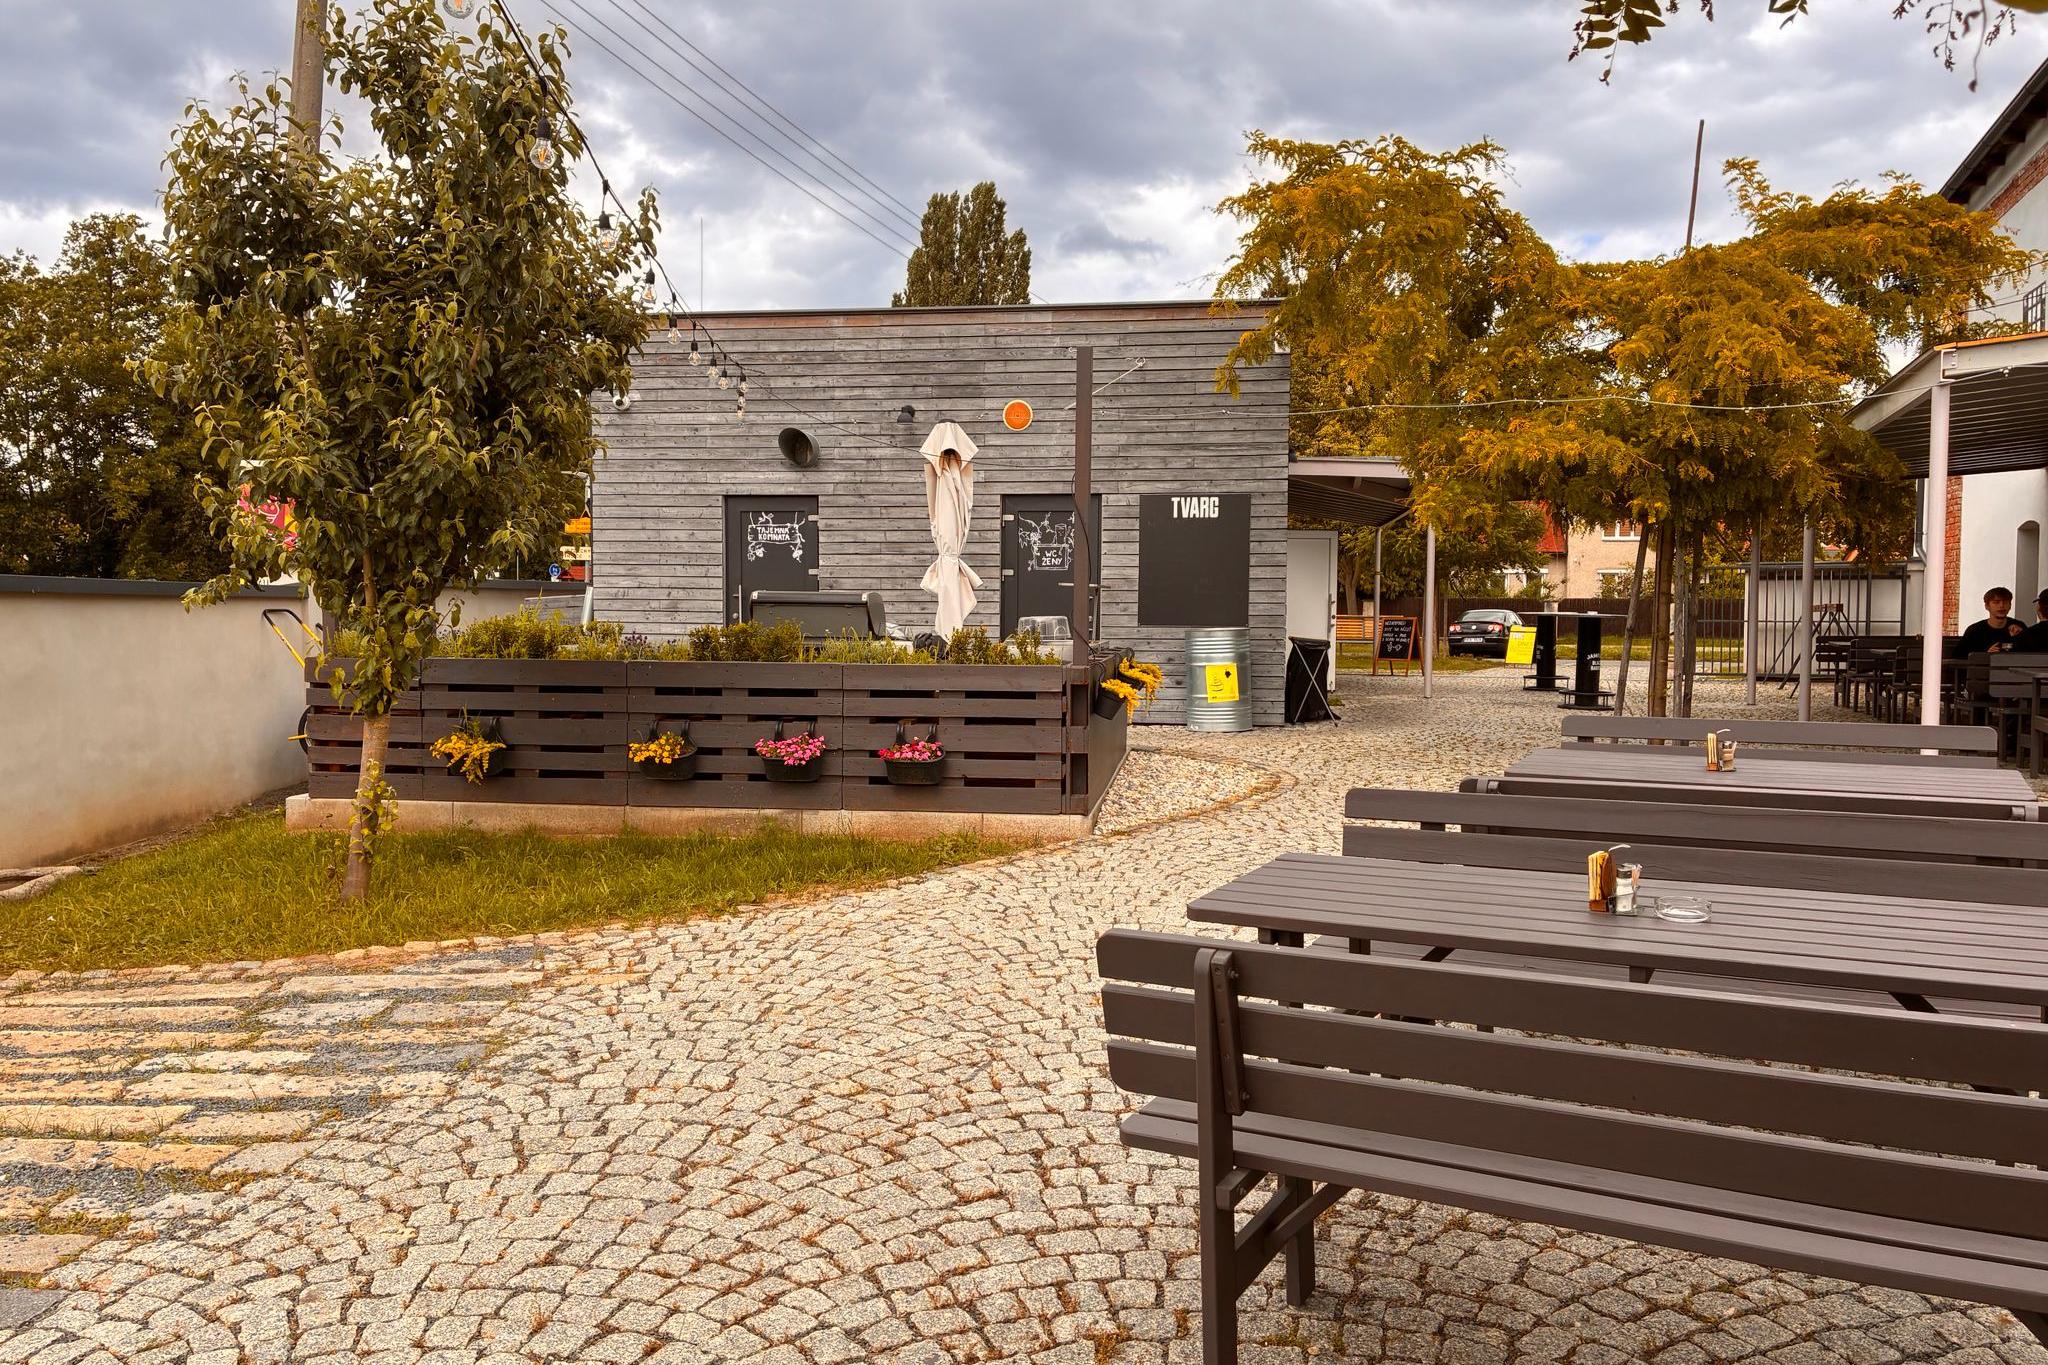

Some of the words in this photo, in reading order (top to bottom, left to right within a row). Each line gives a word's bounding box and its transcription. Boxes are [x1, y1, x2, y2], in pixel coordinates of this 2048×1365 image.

[1171, 496, 1220, 519] TVARG
[758, 533, 791, 541] KOMNATA
[1045, 550, 1058, 558] WC
